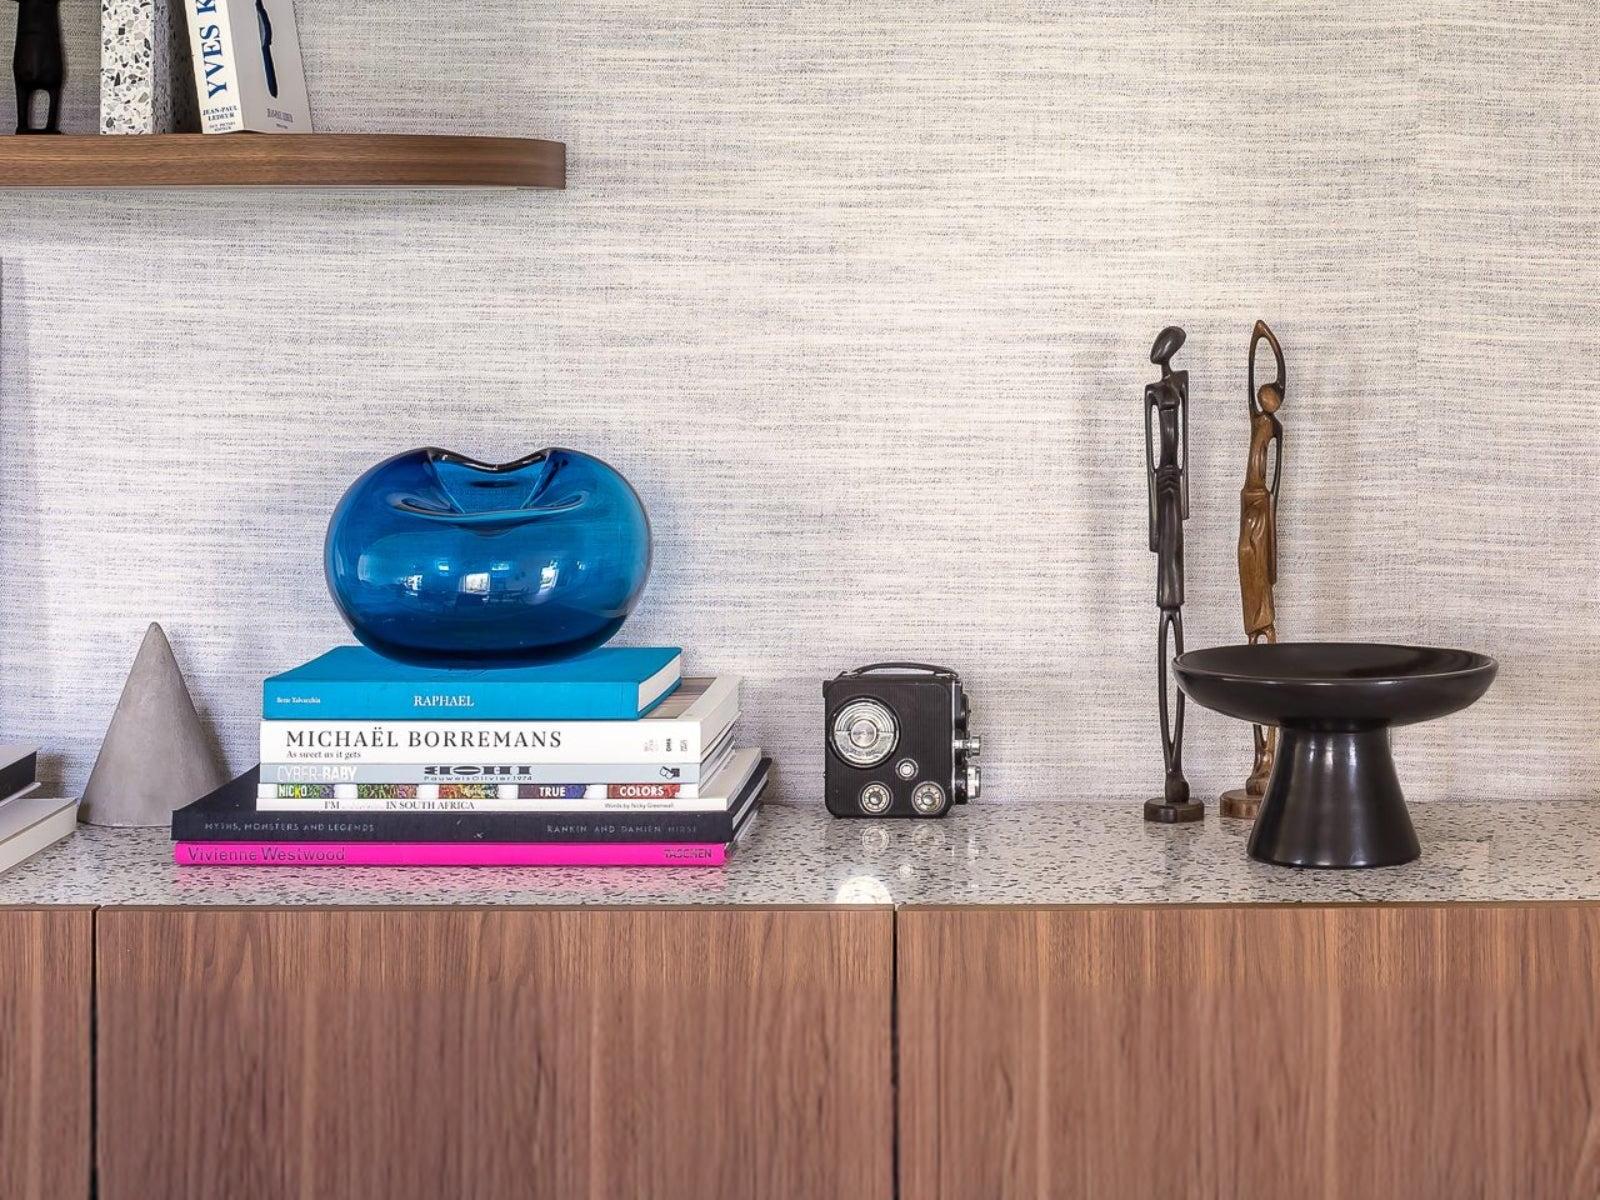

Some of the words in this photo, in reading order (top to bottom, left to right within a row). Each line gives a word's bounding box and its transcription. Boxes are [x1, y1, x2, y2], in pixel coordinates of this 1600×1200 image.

[200, 23, 228, 99] YVES
[413, 695, 474, 707] RAPHAEL
[286, 727, 399, 748] MICHAËL
[408, 731, 562, 748] BORREMANS
[286, 750, 297, 759] As
[299, 750, 322, 759] sweet
[335, 750, 343, 759] it
[344, 750, 361, 761] gets
[277, 766, 358, 782] CYBER-BABY
[539, 786, 566, 797] TRUE
[619, 786, 664, 797] COLORS
[324, 801, 340, 810] I'M
[386, 801, 396, 810] IN
[398, 801, 435, 810] SOUTH
[438, 801, 475, 810] AFRICA
[205, 823, 241, 832] MYTHS,
[244, 823, 299, 832] MONSTERS
[303, 823, 325, 832] AND
[328, 823, 375, 832] LEGENDS
[547, 825, 587, 833] RANKIN
[595, 825, 616, 833] AND
[620, 825, 661, 833] DAMIEN
[188, 847, 257, 861] Vivienne
[261, 847, 345, 861] Westwood
[664, 848, 712, 859] TASCHEN
